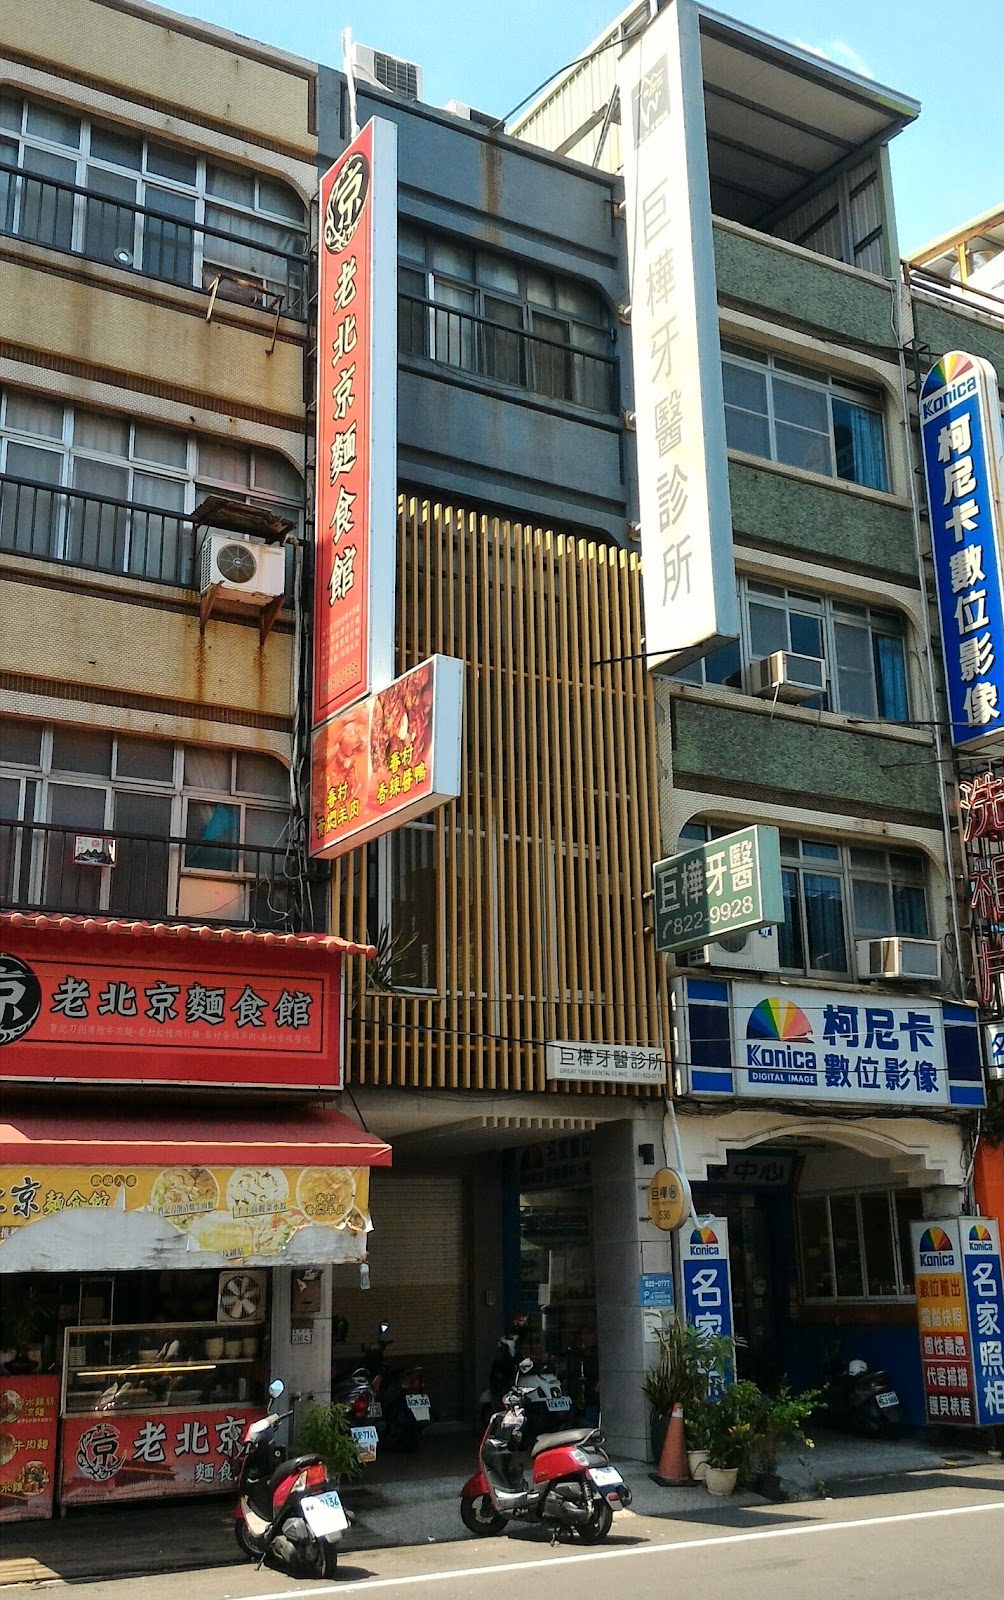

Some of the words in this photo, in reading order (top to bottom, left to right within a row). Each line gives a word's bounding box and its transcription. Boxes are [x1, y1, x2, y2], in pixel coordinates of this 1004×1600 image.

[642, 176, 693, 608] 巨樺牙醫診所
[922, 375, 977, 420] Konica
[328, 255, 357, 606] 老北京麵食館
[937, 411, 1000, 729] 柯尼卡數位影像
[388, 742, 414, 774] 眷村
[326, 780, 349, 809] 眷村
[659, 839, 754, 915] 巨樺牙醫
[673, 895, 754, 936] 822-9928
[50, 974, 313, 1029] 老北京麵食館
[823, 1004, 935, 1052] 柯尼卡
[560, 1048, 663, 1071] 巨樺牙醫診所
[746, 1044, 818, 1069] Konica
[560, 1067, 577, 1075] GREAT
[752, 1072, 785, 1082] DIGITAL
[788, 1074, 815, 1084] IMAGE
[824, 1053, 940, 1093] 數位影像
[651, 1186, 668, 1200] 巨樺
[659, 1210, 671, 1220] 536
[690, 1245, 719, 1256] Konica
[919, 1252, 955, 1267] Konica
[970, 1242, 993, 1251] Konica
[919, 1278, 961, 1299] 數位輸出
[924, 1335, 966, 1356] 個性商品
[927, 1367, 968, 1388] 代客掃描
[132, 1415, 246, 1462] 老北京
[194, 1458, 239, 1484] 麵食
